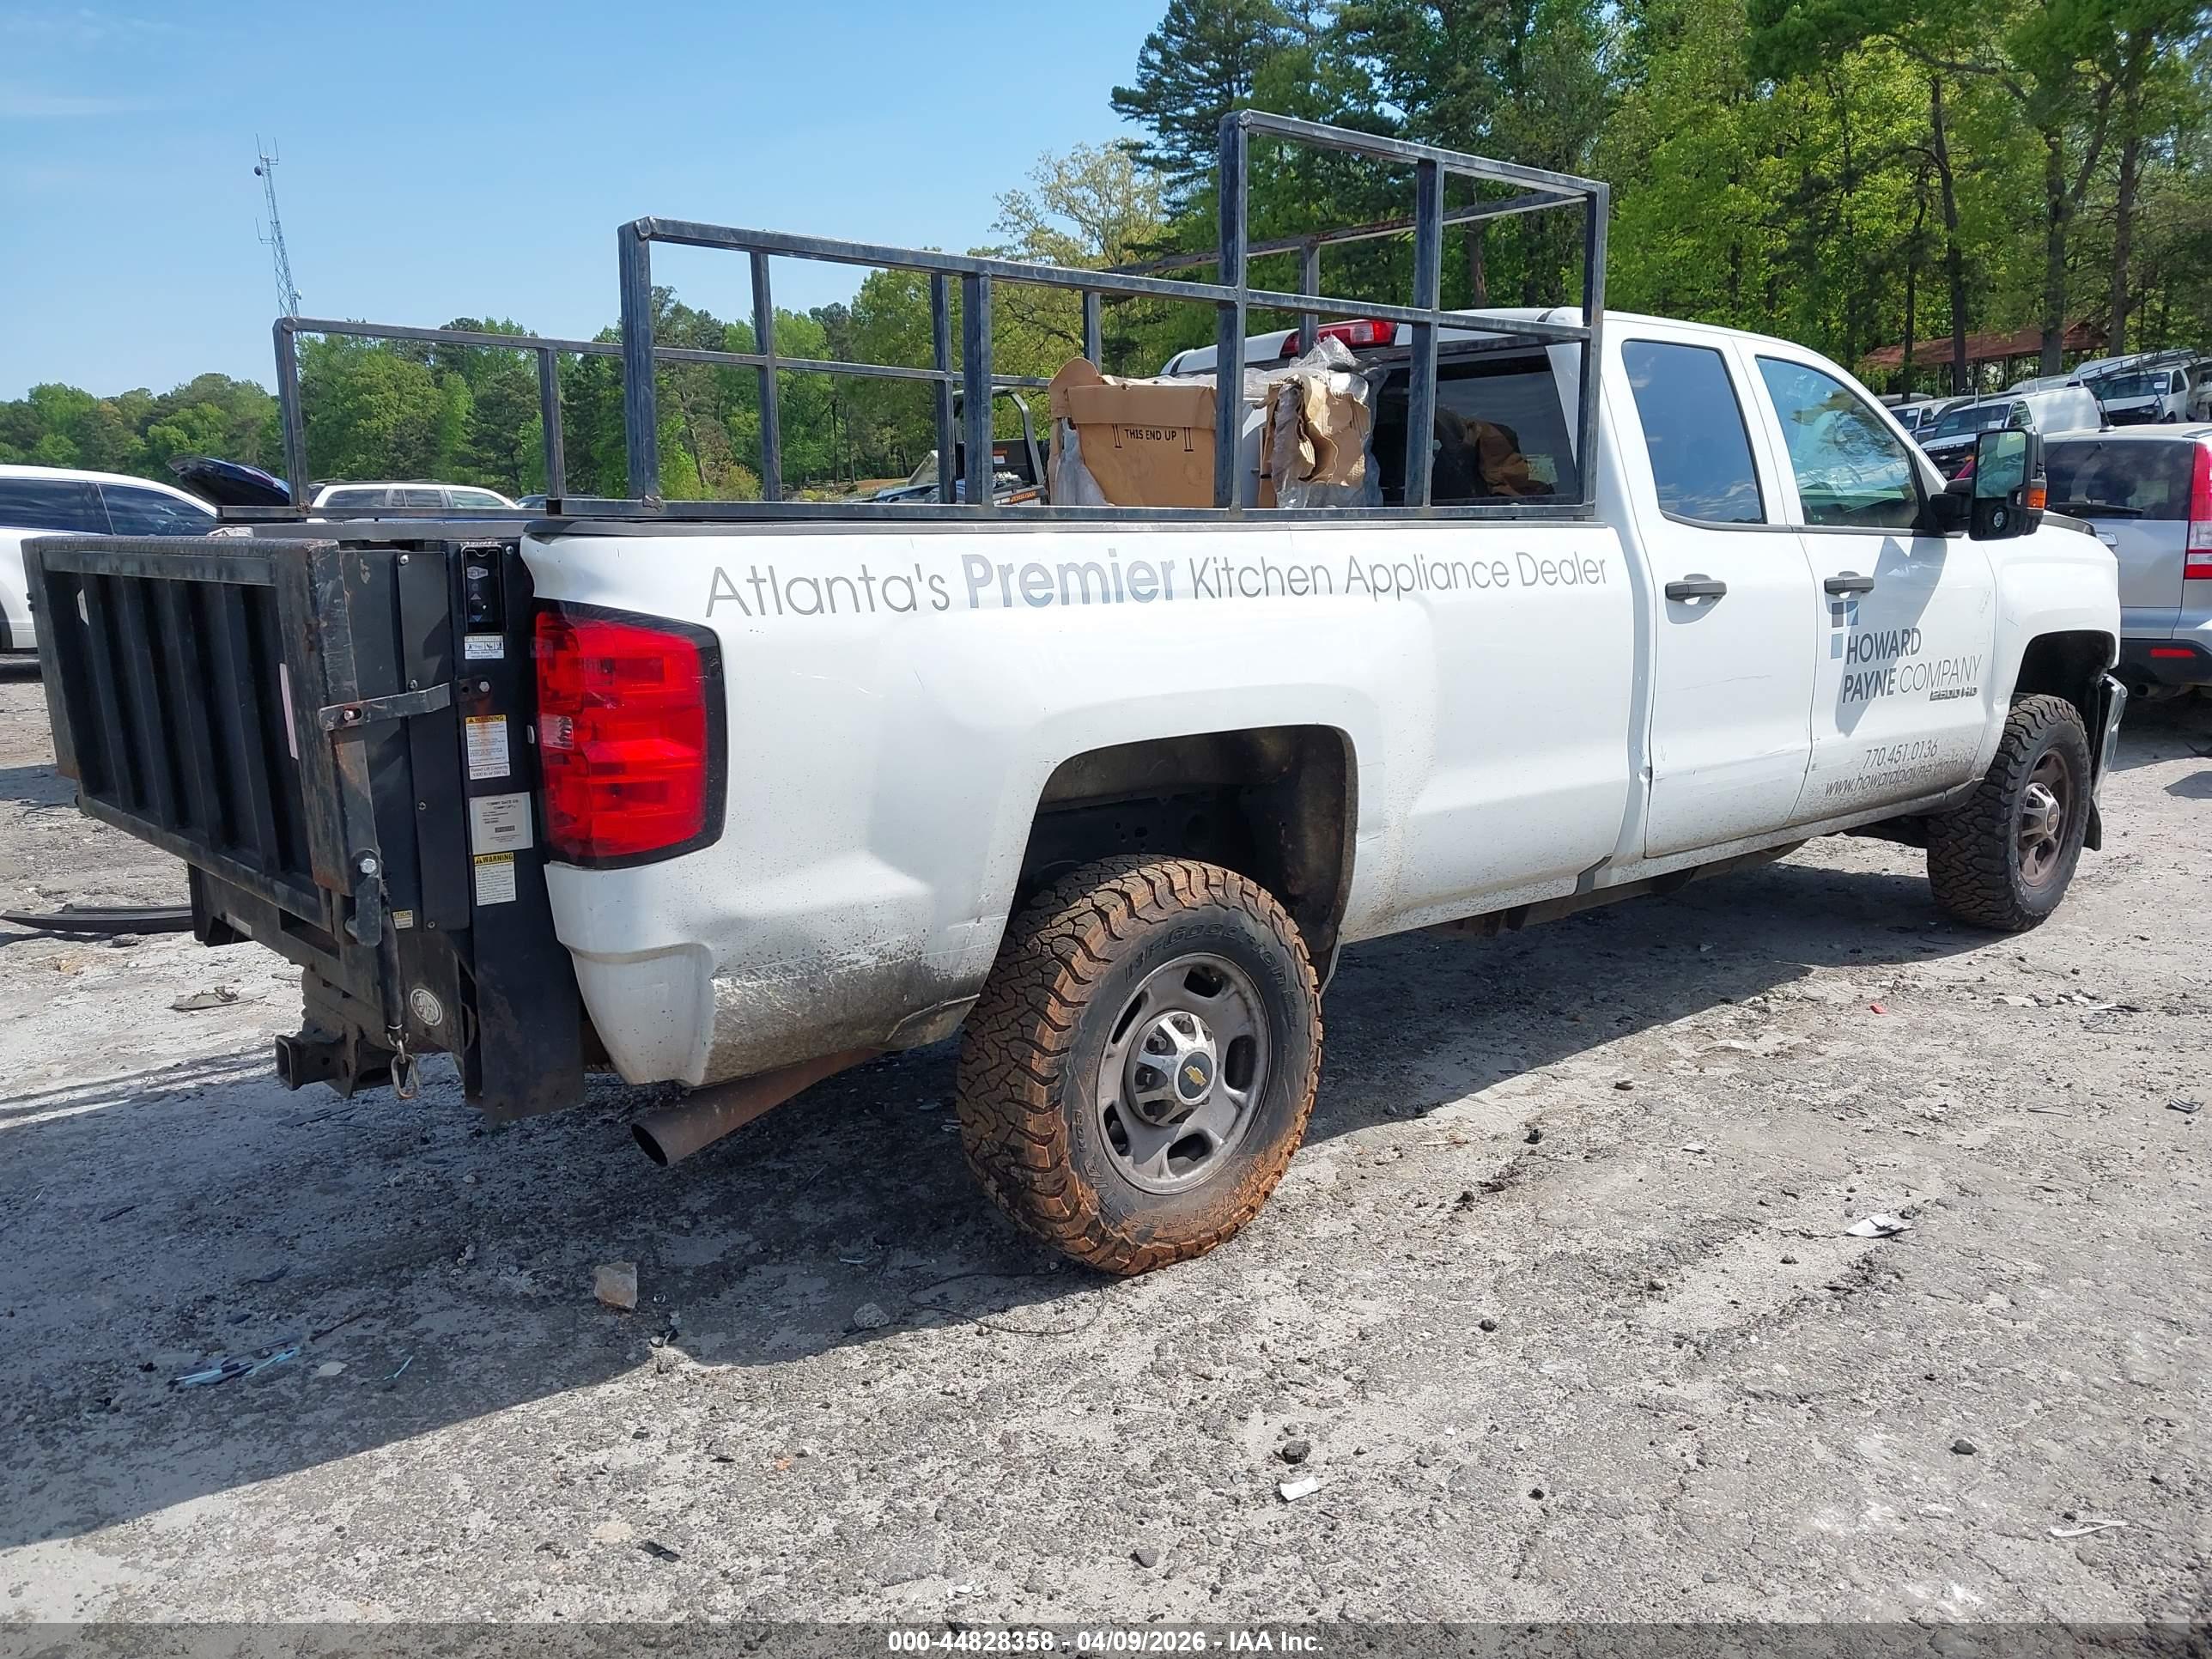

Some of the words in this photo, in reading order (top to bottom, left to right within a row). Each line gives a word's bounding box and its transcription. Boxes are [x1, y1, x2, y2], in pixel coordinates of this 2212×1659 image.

[1124, 428, 1145, 440] THIS
[1146, 429, 1162, 441] END
[1164, 430, 1176, 441] UP
[706, 563, 951, 617] Atlanta's
[961, 548, 1176, 609] Premier
[1188, 556, 1333, 599] Kitchen
[1345, 553, 1510, 602] Appliance
[1516, 551, 1607, 586] Dealer
[1846, 628, 1922, 665] HOWARD
[1842, 667, 1897, 704] PAYNE
[1899, 654, 1983, 694] COMPANY
[1863, 738, 1939, 769] 770.451.0136
[482, 853, 514, 863] WARNING
